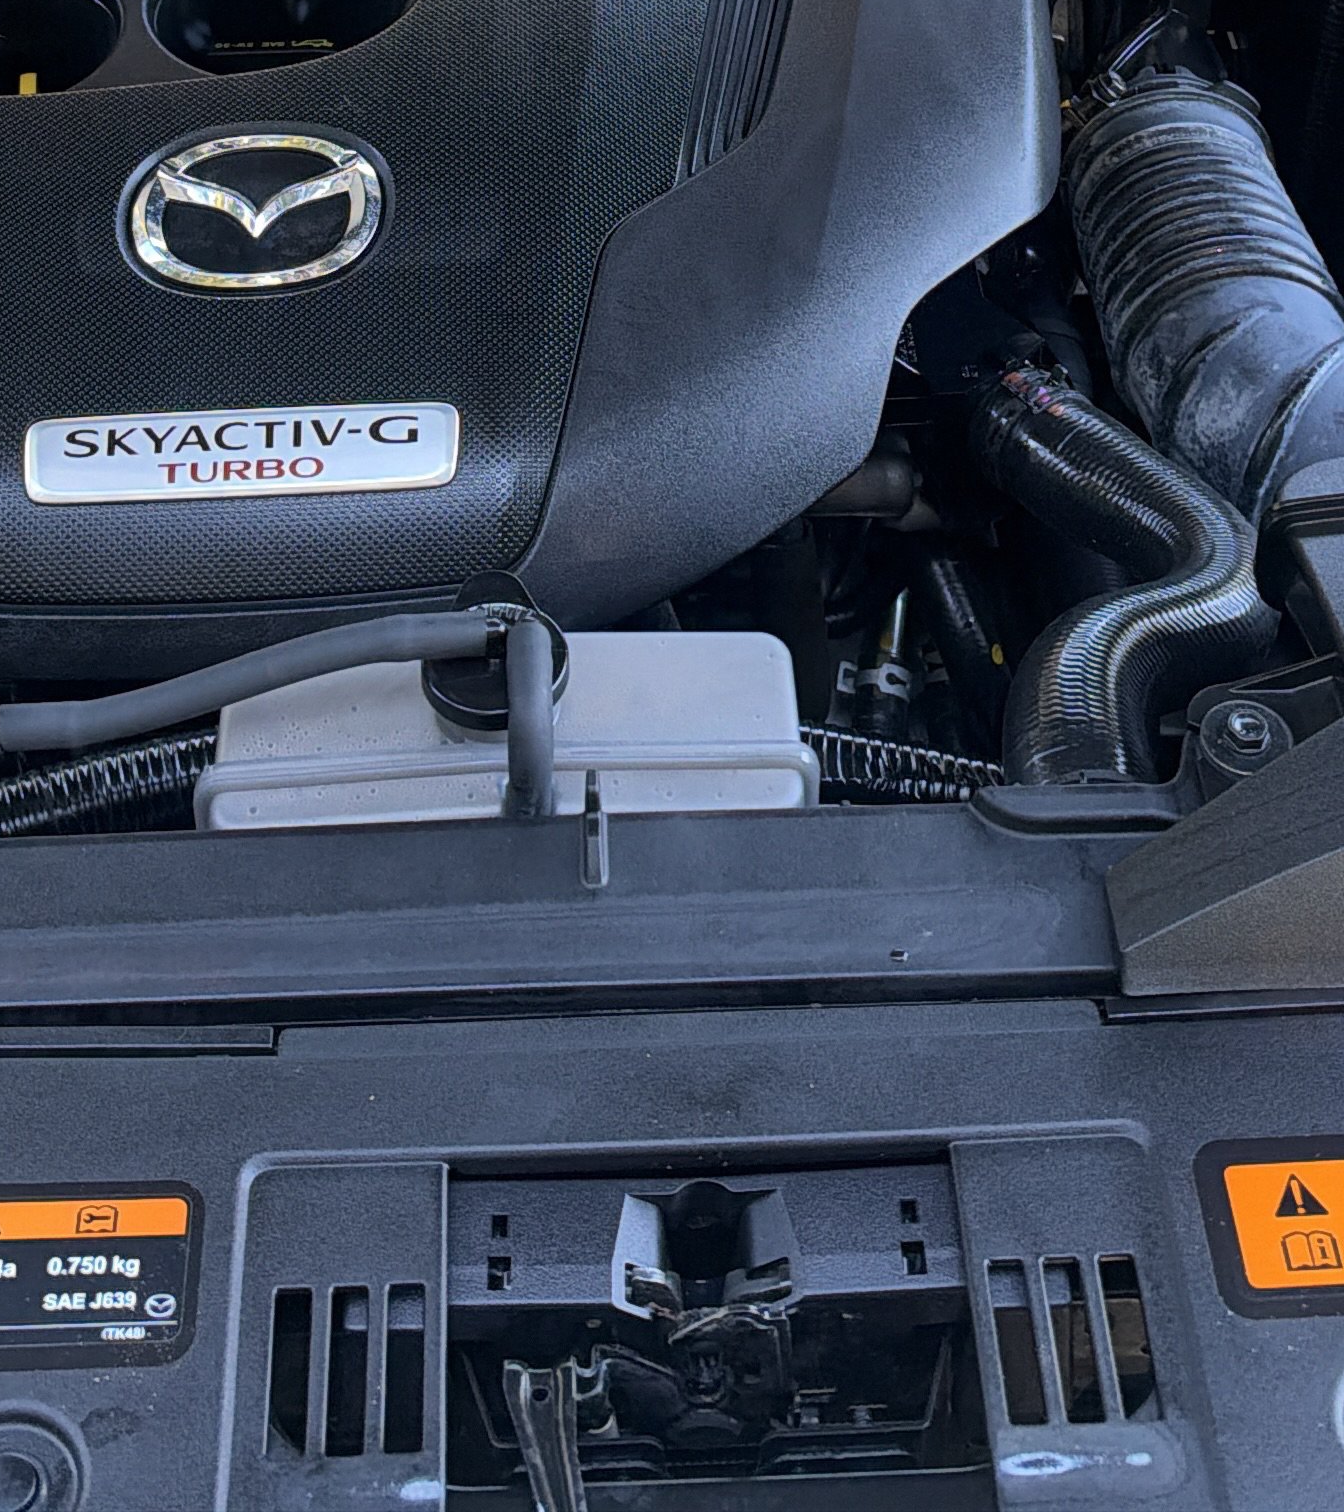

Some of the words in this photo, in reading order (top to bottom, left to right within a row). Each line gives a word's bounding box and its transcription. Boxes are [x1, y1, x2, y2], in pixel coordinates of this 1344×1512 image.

[62, 415, 419, 458] SKYACTIV-G
[158, 456, 324, 484] TURBO
[46, 1255, 108, 1276] 0.750
[111, 1255, 141, 1279] kg
[42, 1293, 86, 1310] SAE
[89, 1291, 137, 1310] J639
